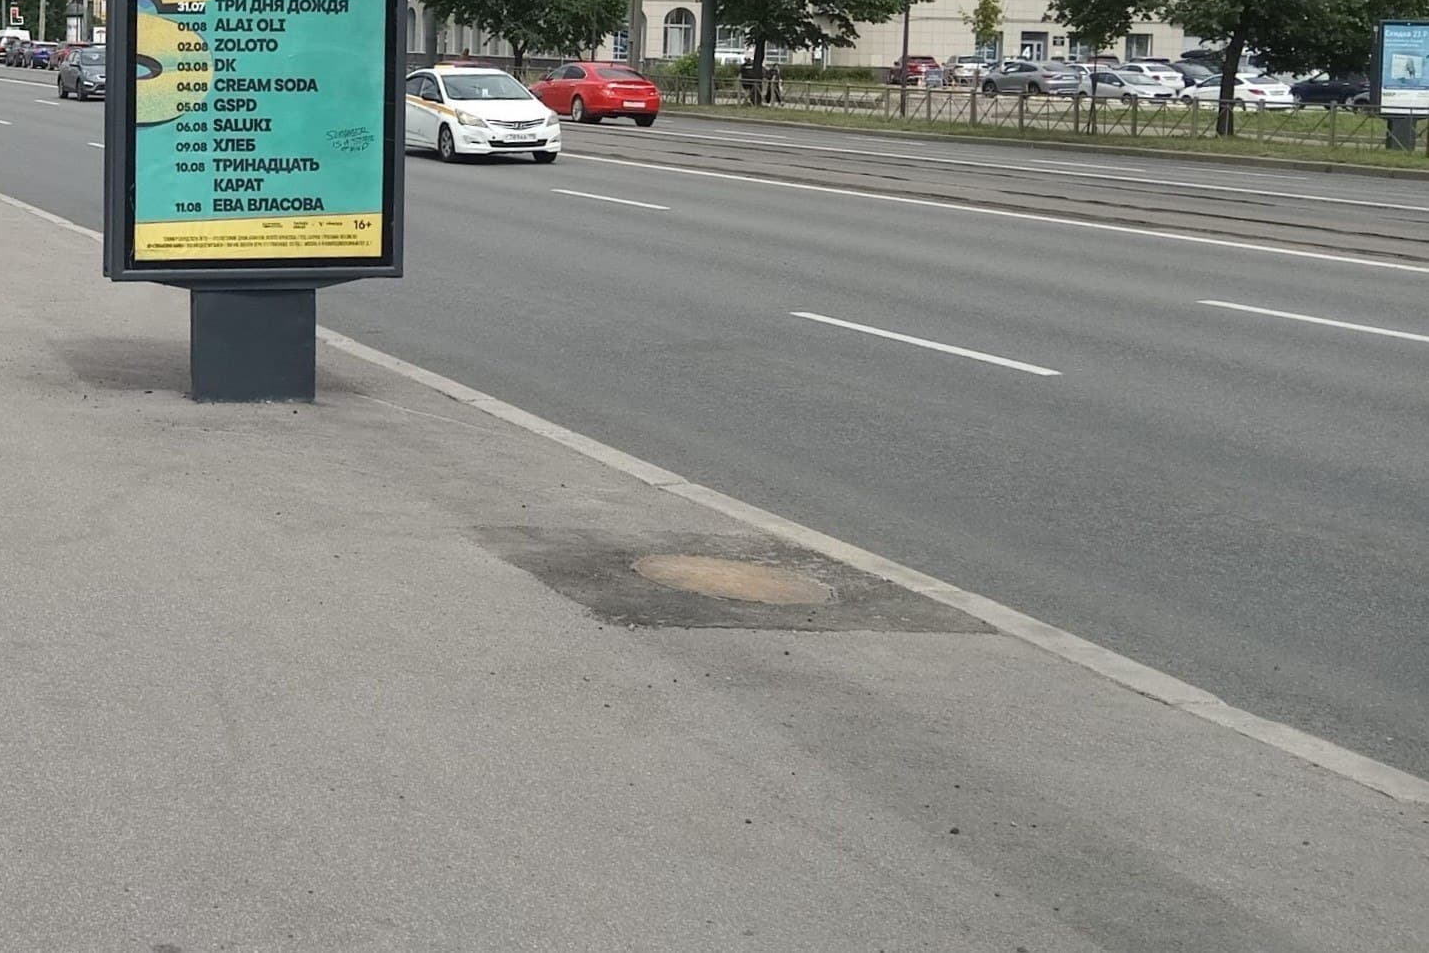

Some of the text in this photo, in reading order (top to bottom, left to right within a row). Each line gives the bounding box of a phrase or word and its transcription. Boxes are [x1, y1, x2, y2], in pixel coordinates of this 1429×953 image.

[177, 0, 349, 14] 31.07 ТРИ ДНЯ ДОЖДЯ
[177, 19, 286, 32] 01.08 ALAI OLI
[177, 39, 279, 53] 02.08 ZOLOTO
[177, 59, 237, 73] 03.08 DK
[176, 79, 319, 92] 04.08 CREAM SODA
[176, 99, 257, 112] 05.08 GSPD
[176, 119, 272, 133] 06.08 SALUKI
[176, 139, 256, 152] 09.08 ХЛЕБ
[176, 158, 320, 174] 10.08 ТРИНАДЦАТЬ
[214, 179, 264, 192] КАРАТ
[175, 198, 324, 213] 11.08 ЕВА ВЛАСОВА
[354, 220, 372, 230] 16+
